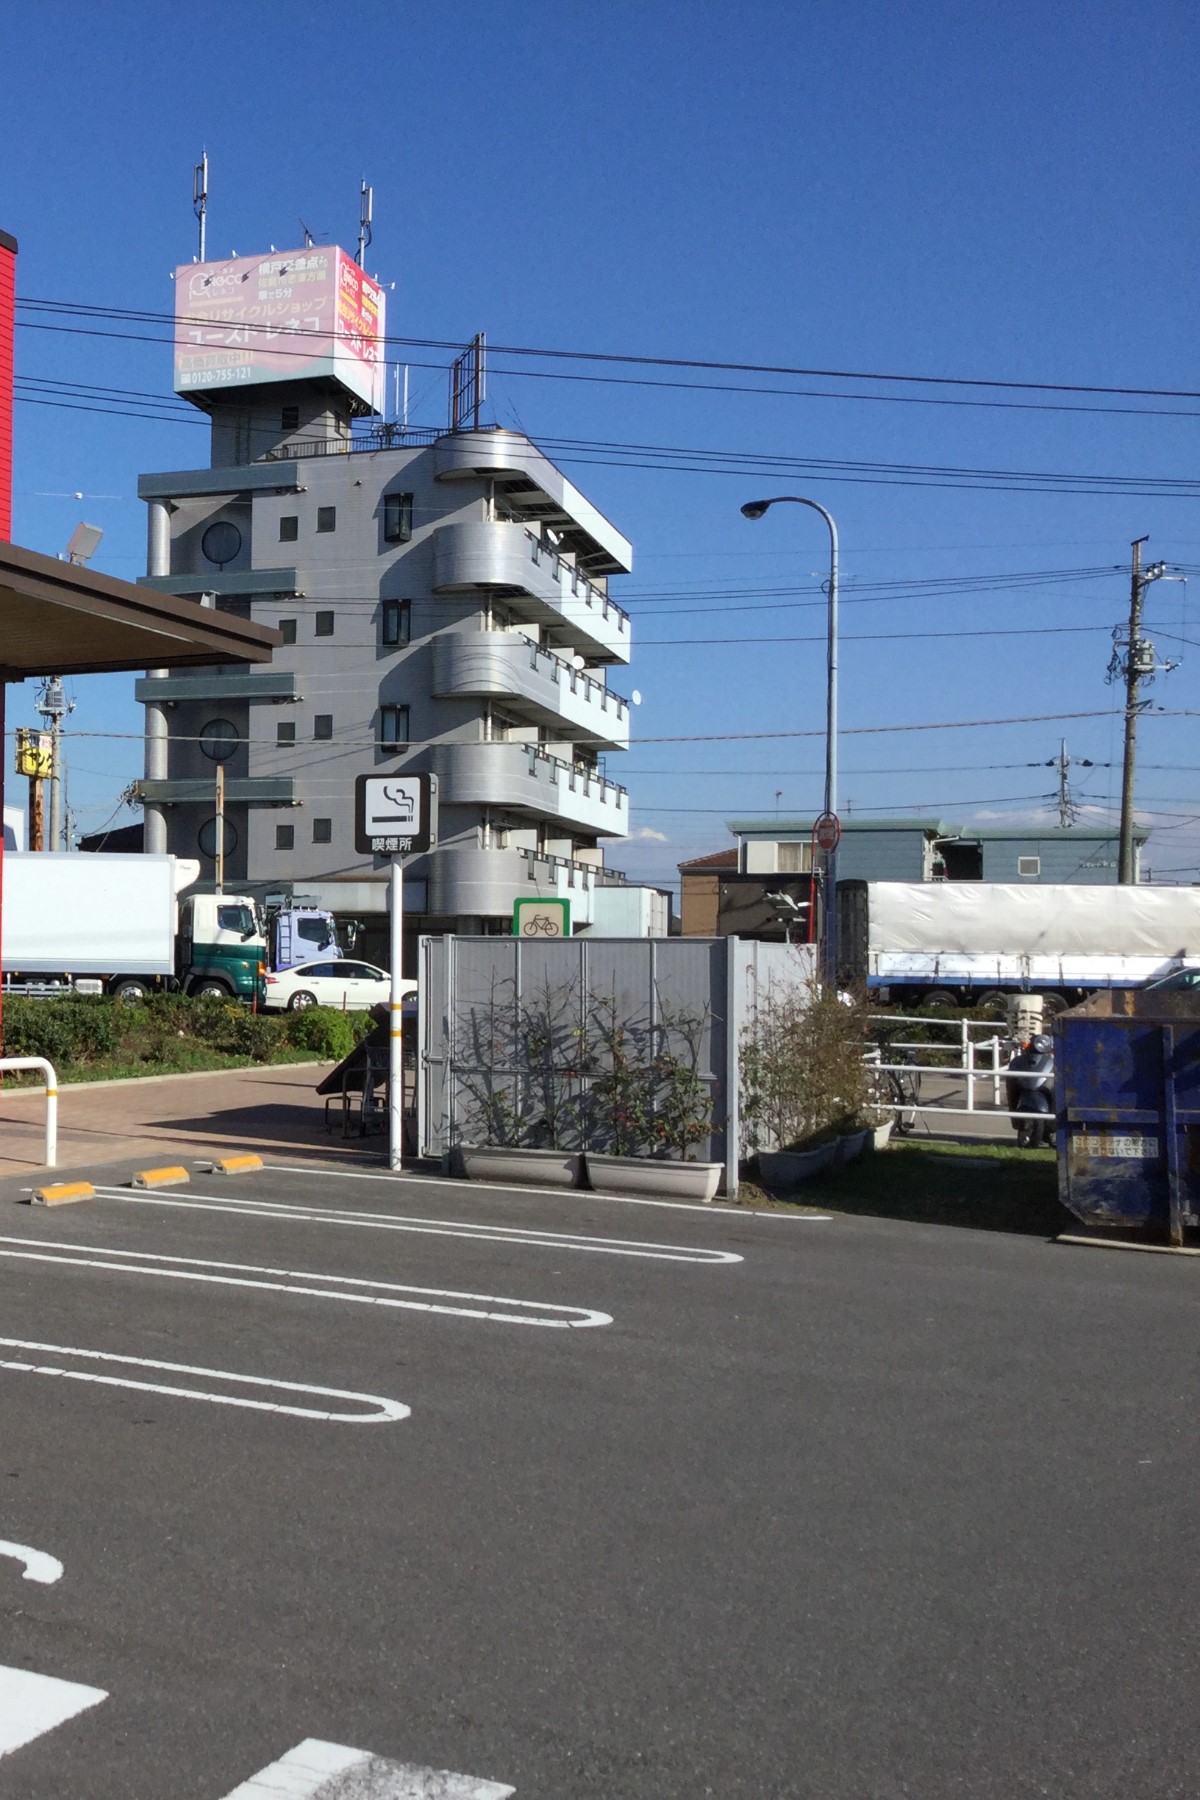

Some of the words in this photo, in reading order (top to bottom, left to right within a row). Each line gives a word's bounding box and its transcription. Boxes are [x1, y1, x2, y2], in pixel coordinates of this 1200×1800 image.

[187, 323, 258, 348] ユーズド
[266, 316, 320, 340] レネコ
[191, 367, 251, 384] 0120-755-121
[371, 837, 412, 851] 喫煙所
